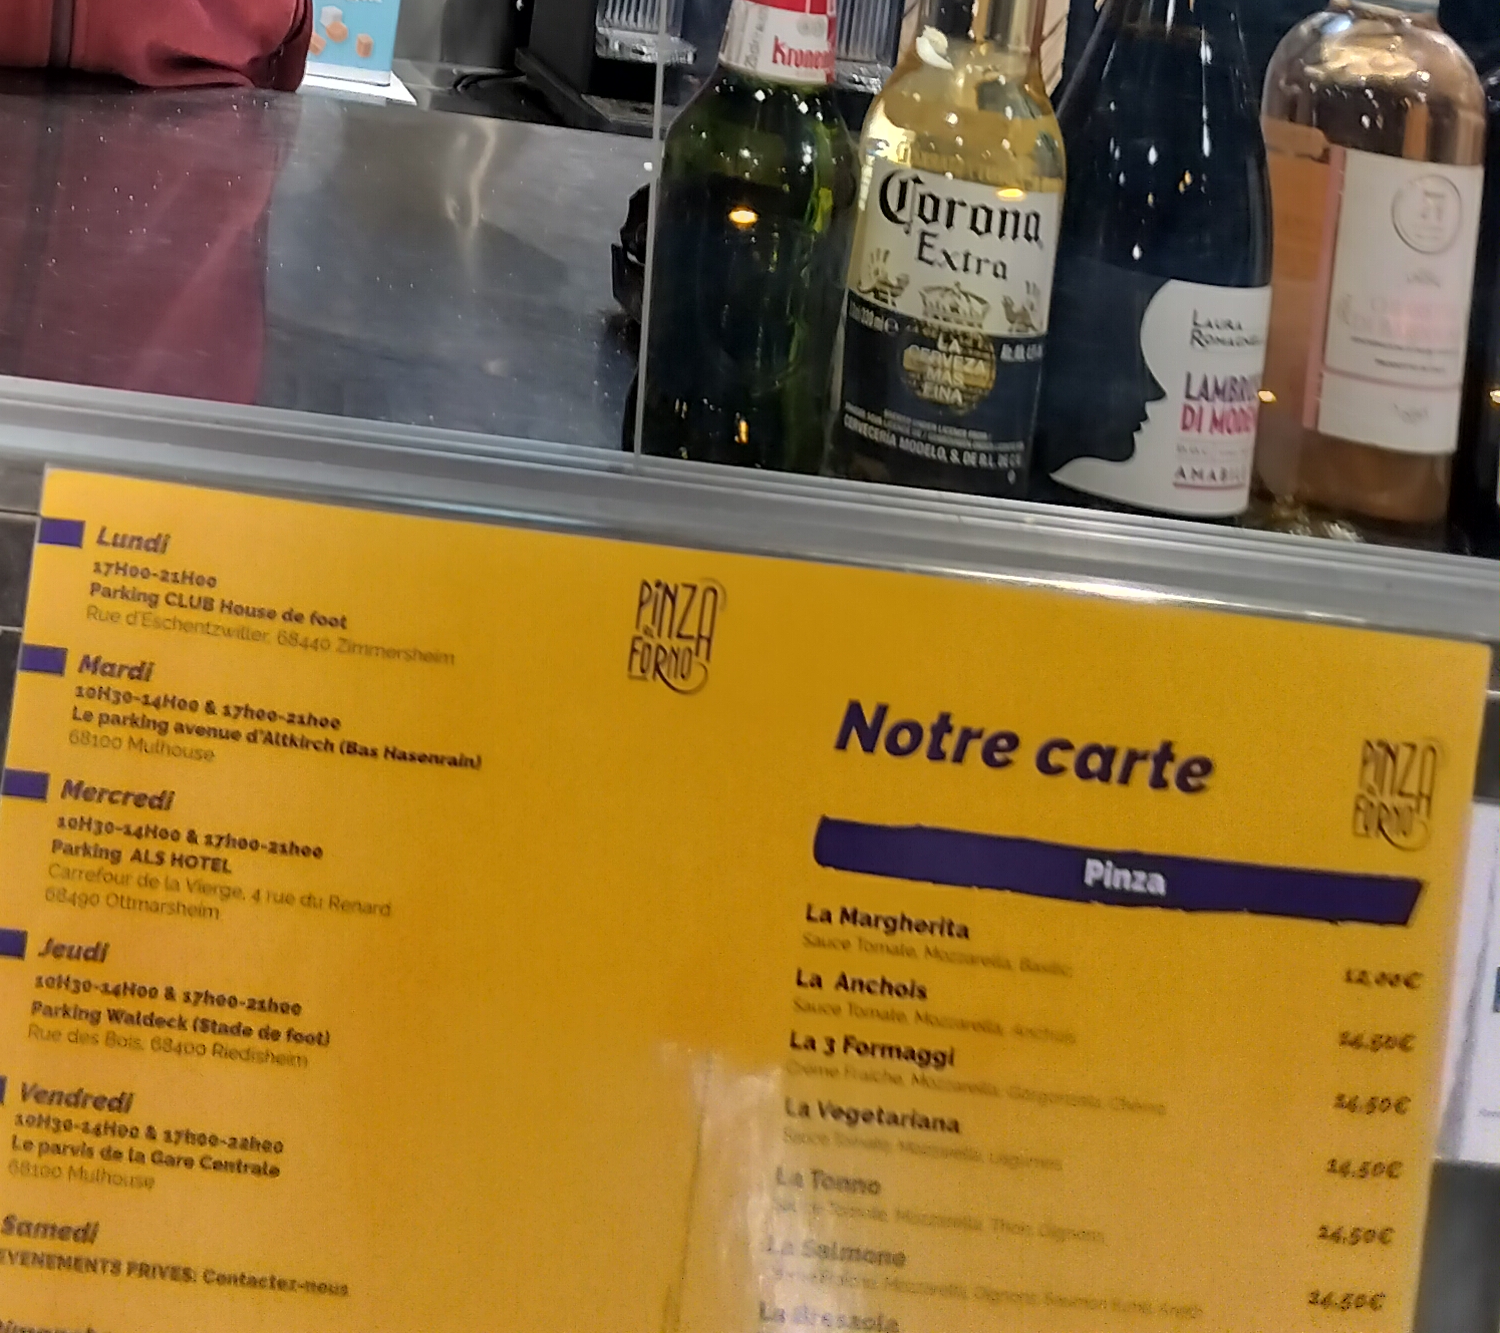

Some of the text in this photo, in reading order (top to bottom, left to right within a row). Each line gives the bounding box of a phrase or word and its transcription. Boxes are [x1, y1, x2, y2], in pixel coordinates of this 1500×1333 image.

[878, 167, 1043, 245] Corona
[916, 230, 1009, 280] Extra
[1180, 403, 1203, 434] DI
[96, 525, 171, 555] Lundi
[89, 582, 348, 630] Parking CLUB House de foot
[87, 605, 122, 626] Rue
[337, 638, 456, 666] Zimmersheim
[77, 653, 155, 682] Mardi
[205, 700, 217, 716] &
[68, 729, 215, 763] 68100 Mulhouse
[72, 706, 482, 771] Le parking avenue d'Altkirch (Bas Hasenrain)
[834, 698, 1216, 795] Notre carte
[60, 778, 176, 812] Mercredi
[185, 829, 199, 845] &
[51, 839, 233, 875] Parking ALS HOTEL
[48, 863, 132, 887] Carrefour
[136, 873, 160, 889] de
[164, 875, 180, 892] la
[251, 888, 261, 903] 4
[300, 894, 323, 911] du
[328, 894, 392, 917] Renard
[1082, 857, 1168, 897] Pinza
[105, 892, 220, 921] Ottmarsheim
[805, 903, 970, 940] La Margherita
[38, 937, 111, 964] Jeudi
[164, 986, 176, 1002] &
[796, 967, 928, 1001] La Anchois
[31, 1000, 331, 1047] Parking Waldeck (Stade de foot)
[28, 1024, 62, 1042] Rue
[68, 1027, 99, 1046] des
[211, 1042, 308, 1069] Riedisheim
[789, 1029, 956, 1071] La 3 Formaggi
[20, 1081, 135, 1114] Vendredi
[784, 1096, 961, 1134] La Vegetariana
[145, 1125, 158, 1141] &
[11, 1134, 281, 1179] Le parvis de la Gare Centrale
[68, 1164, 155, 1190] Mulhouse
[776, 1165, 882, 1196] La Tonno
[0, 1213, 99, 1244] Samedi
[202, 1267, 349, 1296] Contactez-nous
